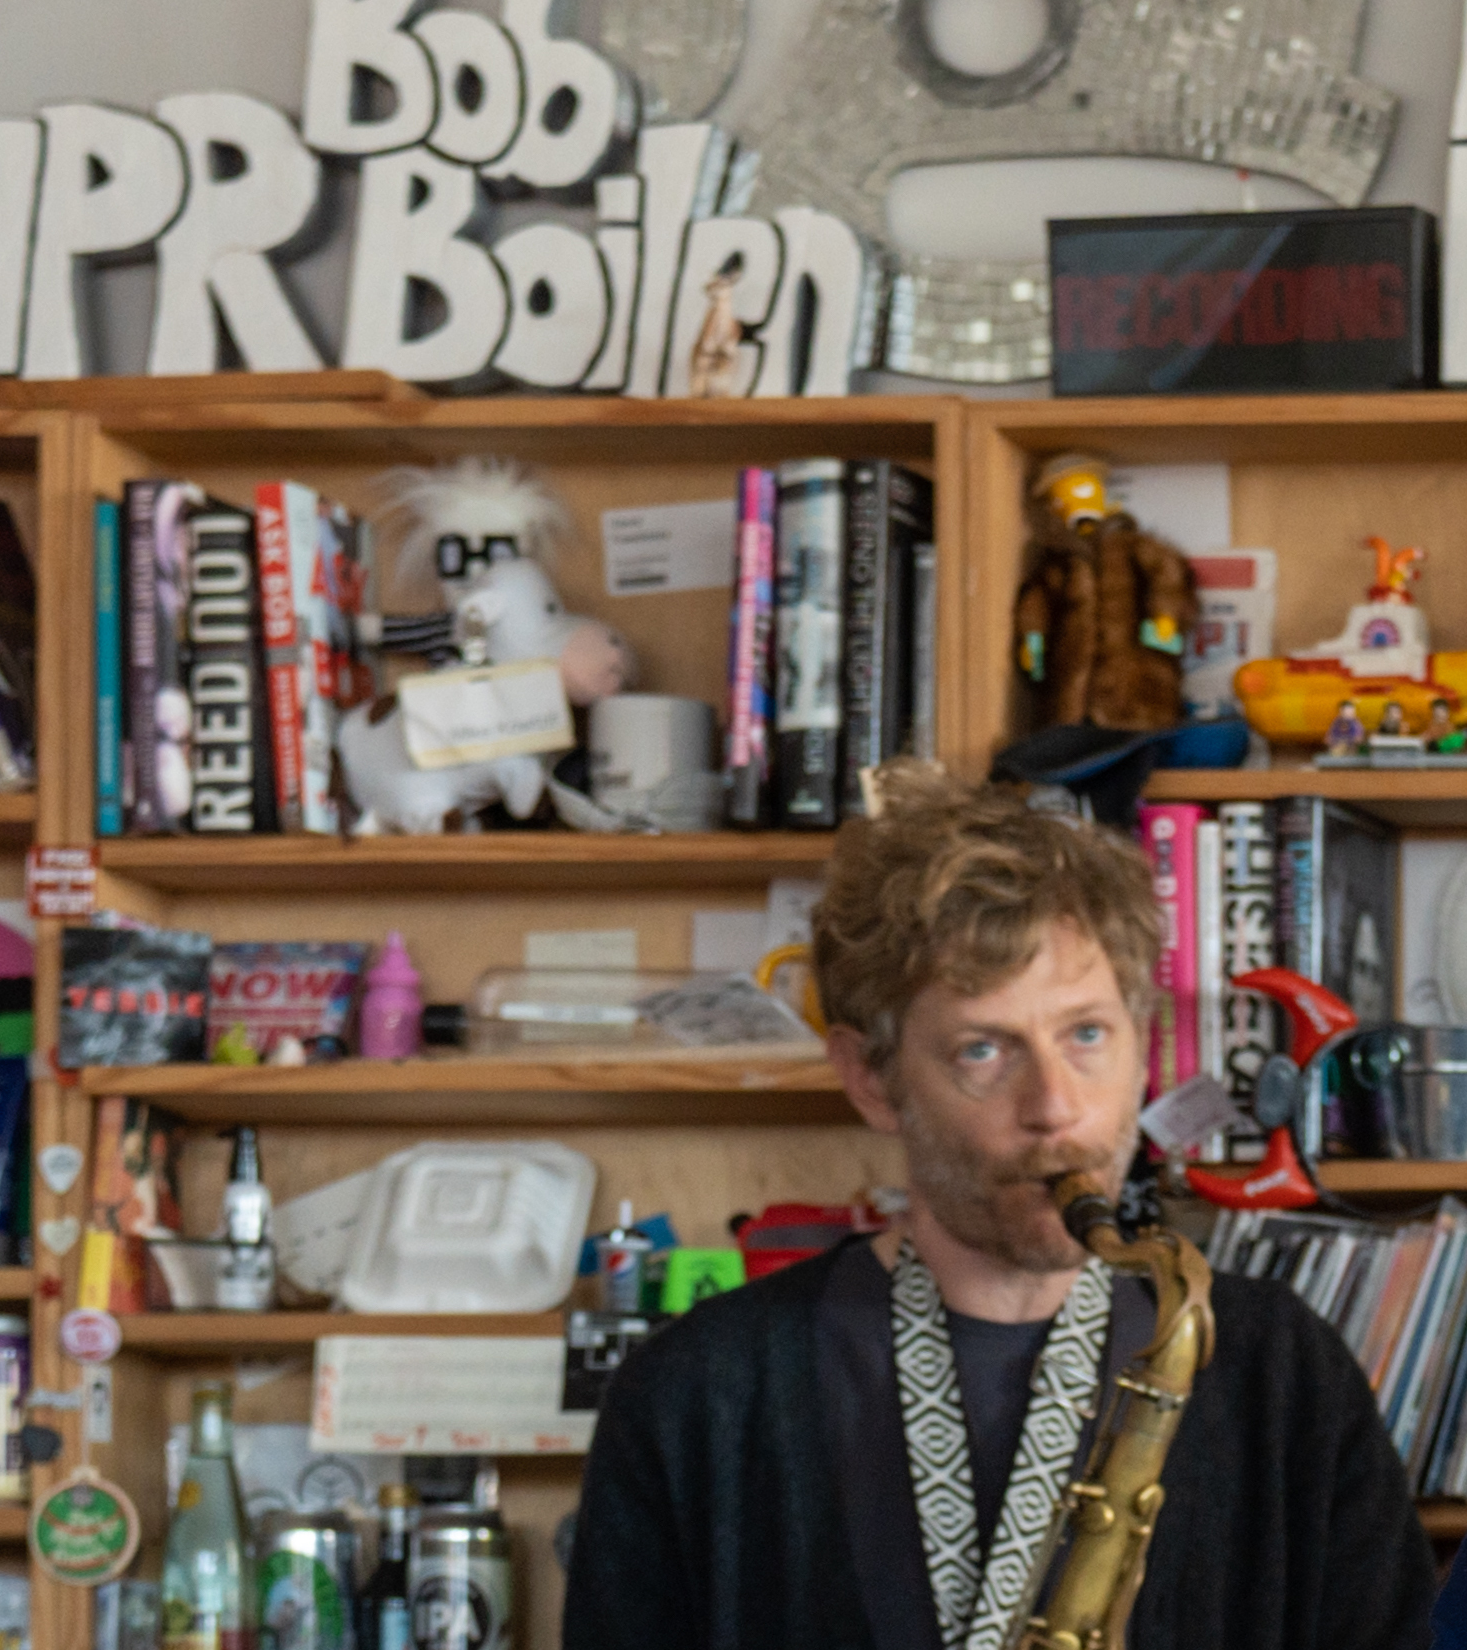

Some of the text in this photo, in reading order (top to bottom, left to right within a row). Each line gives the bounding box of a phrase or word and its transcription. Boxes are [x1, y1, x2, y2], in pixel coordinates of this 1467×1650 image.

[303, 0, 618, 187] Bob
[341, 118, 865, 398] Boilen
[1056, 263, 1408, 352] RECORDING
[257, 506, 293, 640] ASK BOB
[191, 661, 254, 831] REED
[414, 1601, 480, 1641] IPA
